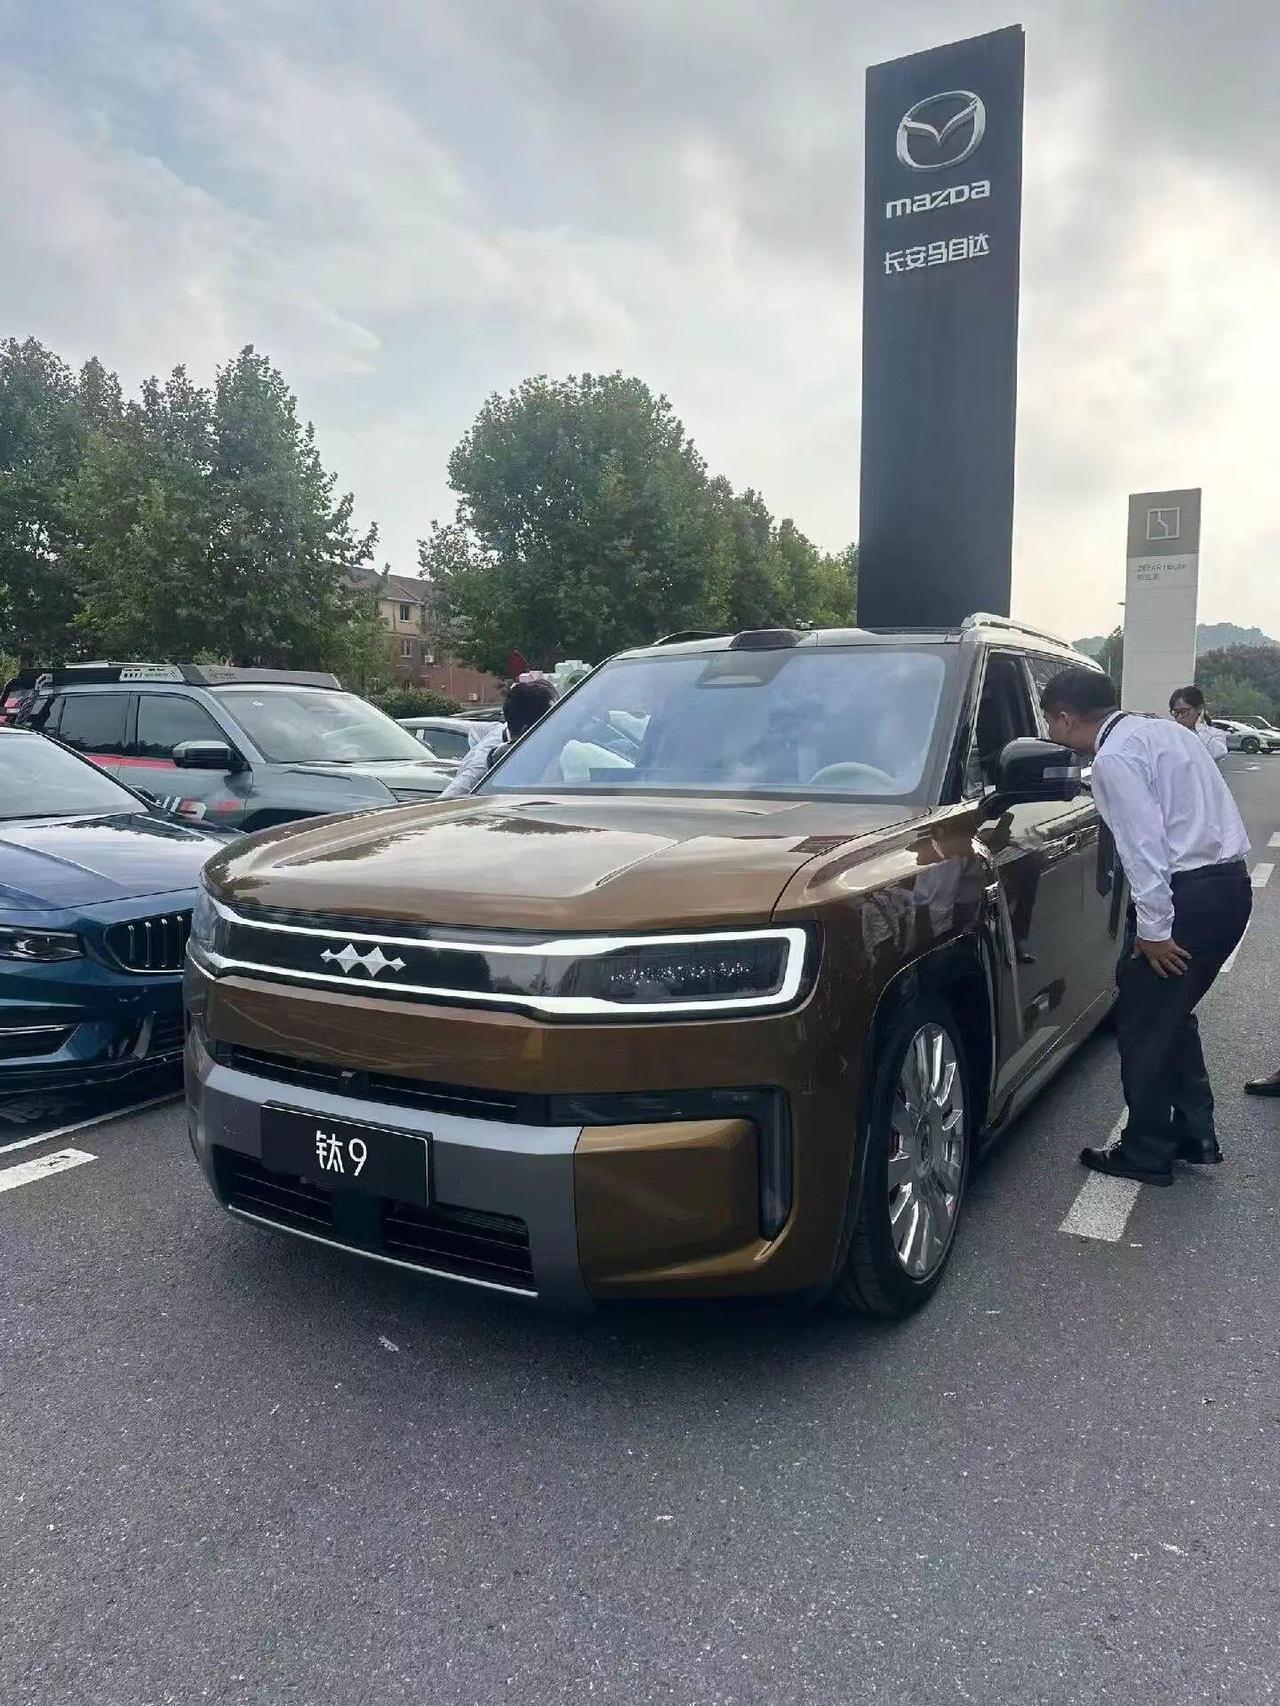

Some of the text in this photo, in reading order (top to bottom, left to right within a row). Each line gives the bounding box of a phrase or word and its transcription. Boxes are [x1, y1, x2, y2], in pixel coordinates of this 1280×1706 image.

[884, 232, 990, 274] 长安马自达
[315, 1130, 368, 1177] 钛9
